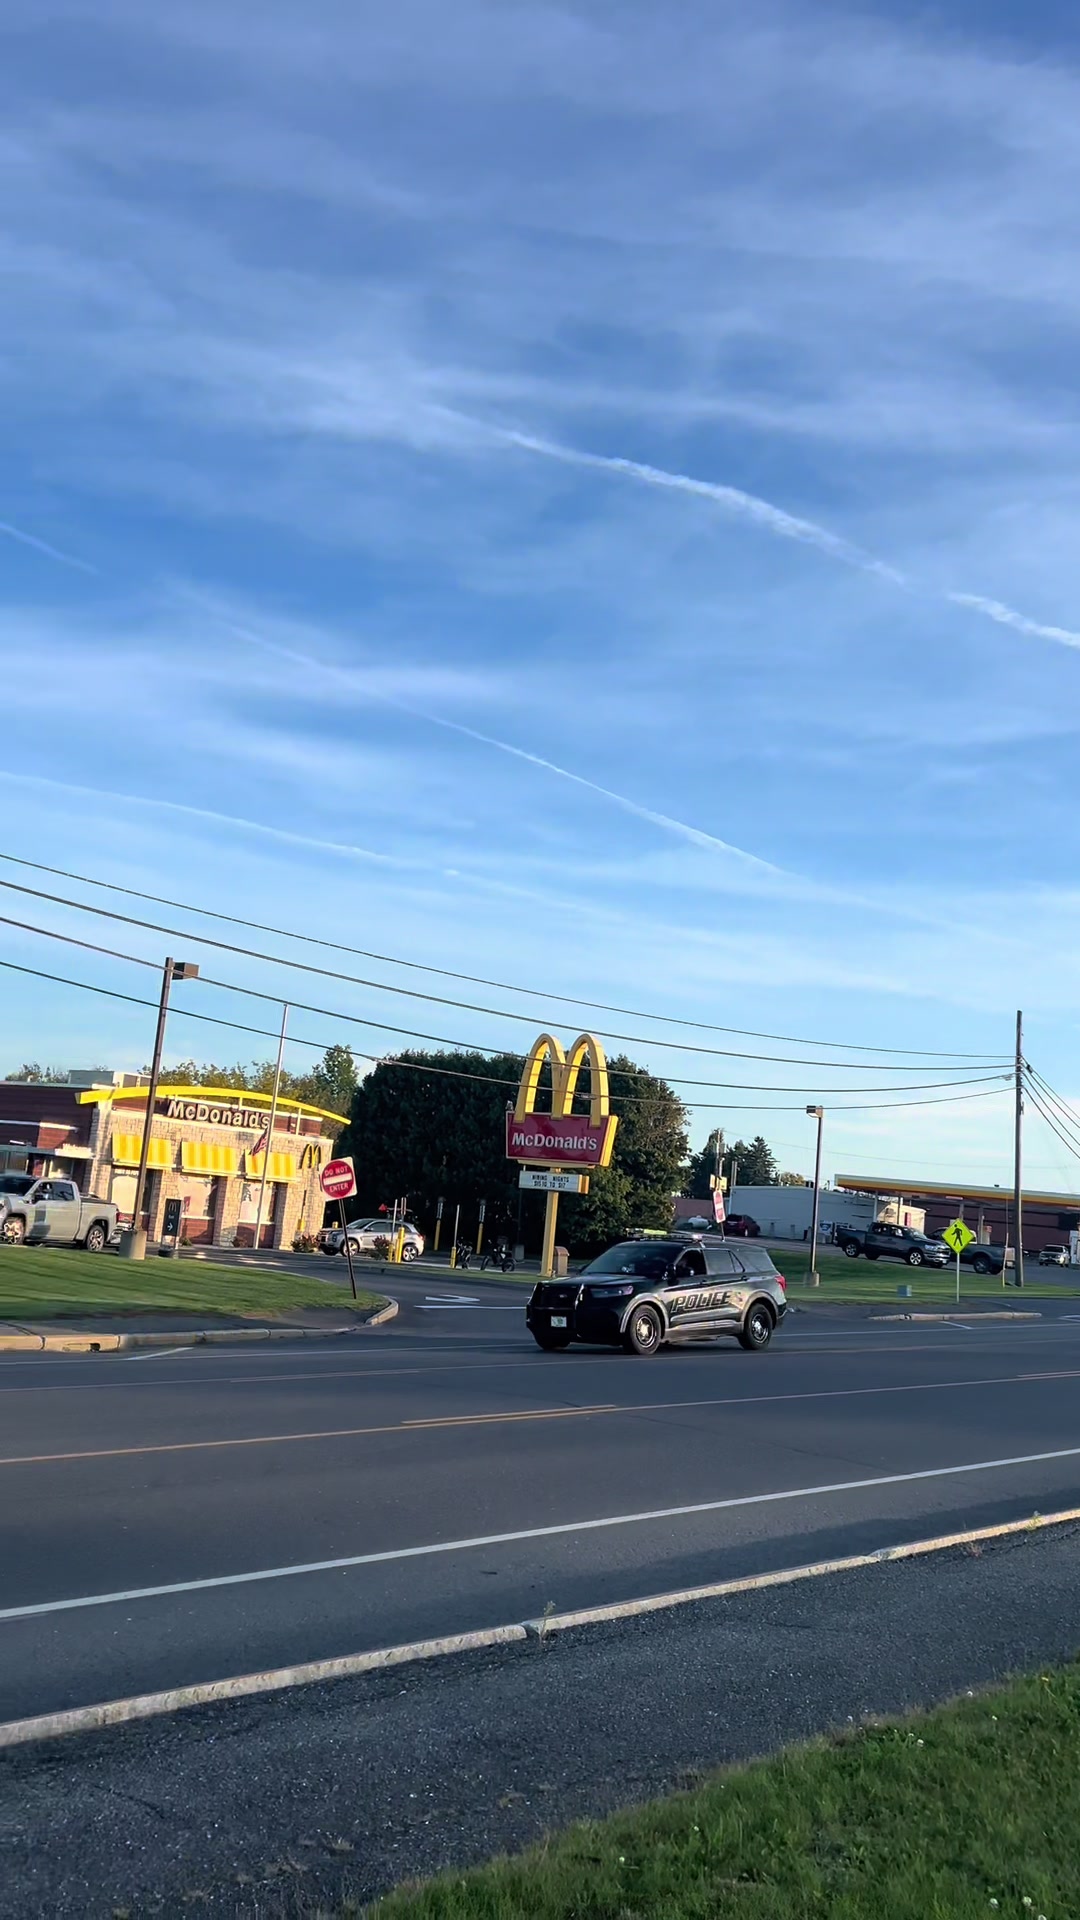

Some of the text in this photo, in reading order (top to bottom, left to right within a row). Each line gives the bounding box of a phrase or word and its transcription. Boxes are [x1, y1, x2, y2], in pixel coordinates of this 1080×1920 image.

[167, 1100, 271, 1130] McDonald's
[512, 1132, 597, 1151] McDonald's
[324, 1166, 348, 1177] DO NOT
[329, 1183, 349, 1192] ENTER
[671, 1291, 732, 1312] POLICE
